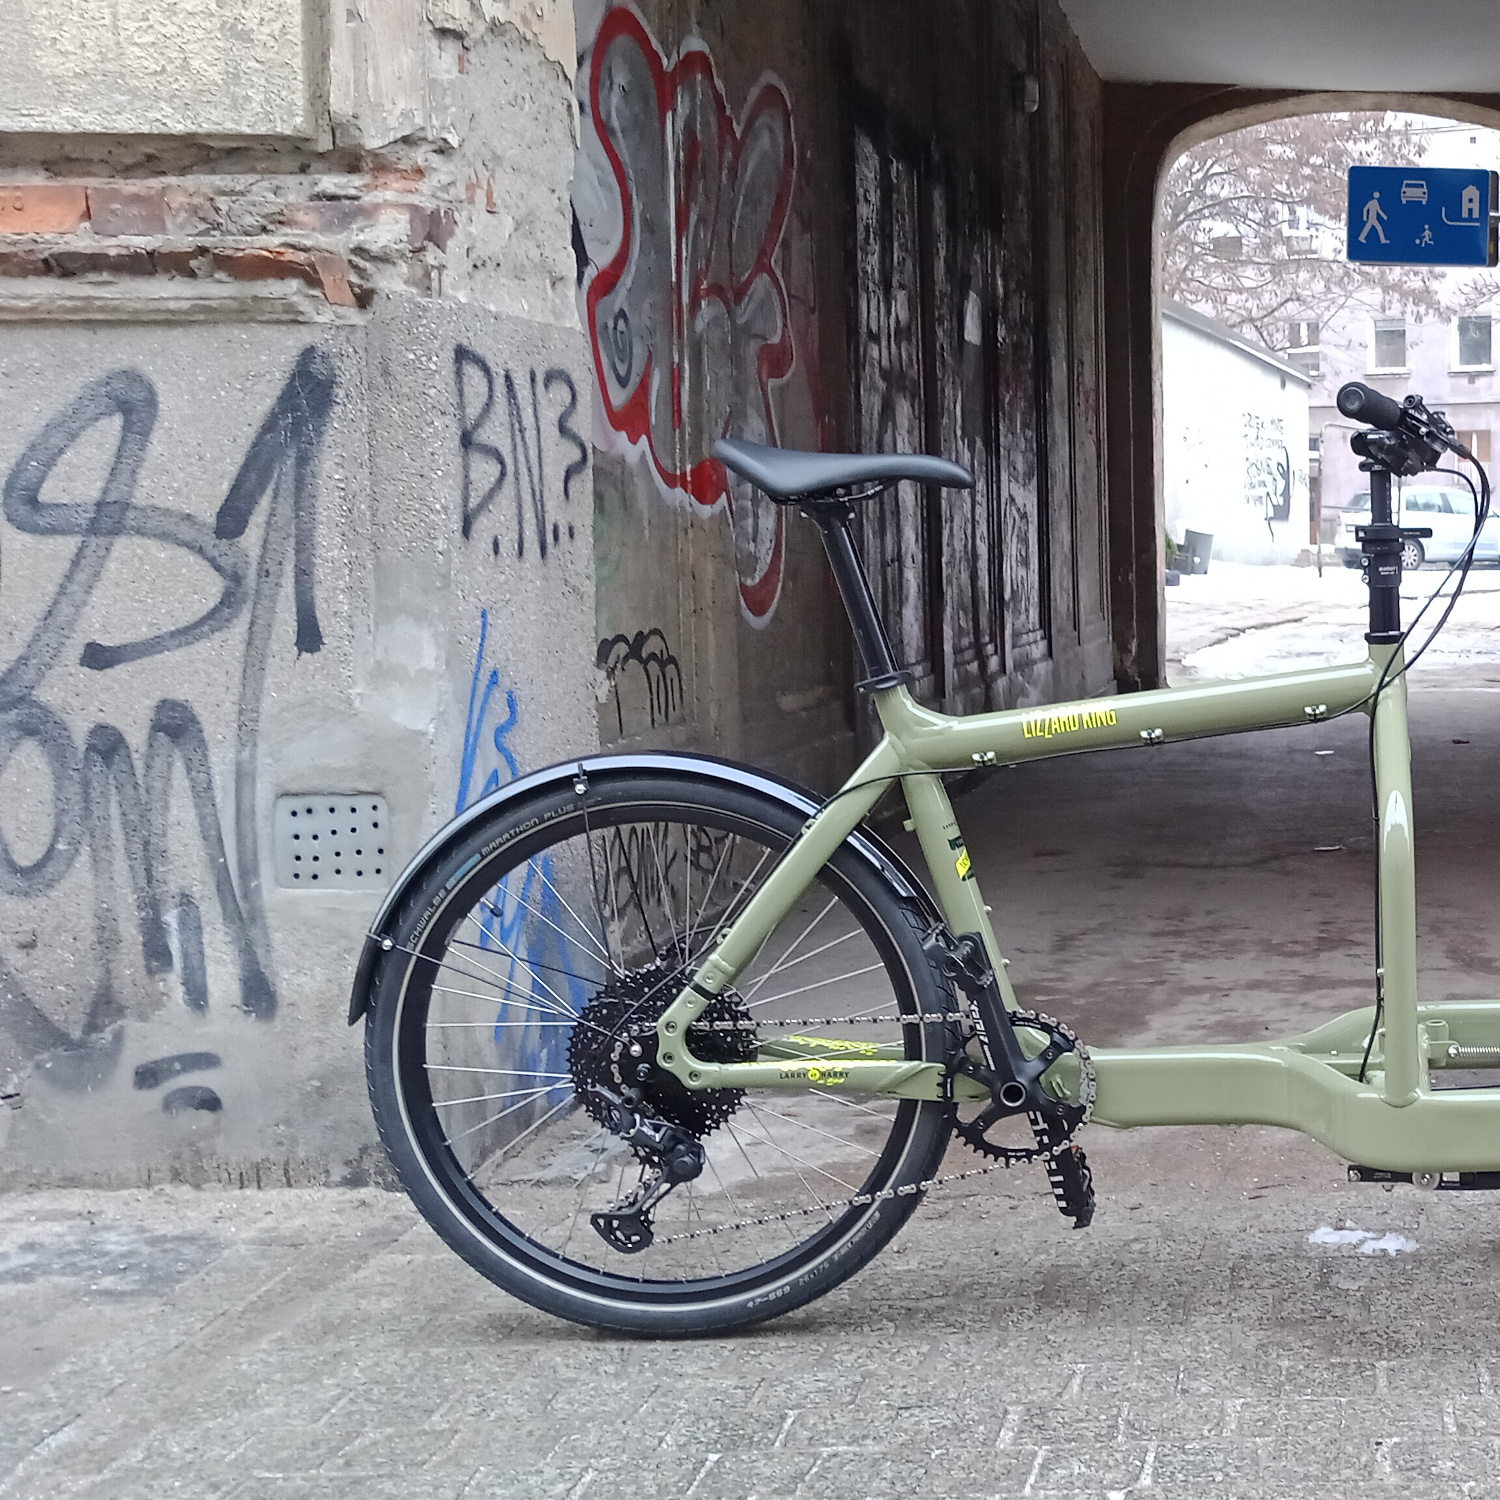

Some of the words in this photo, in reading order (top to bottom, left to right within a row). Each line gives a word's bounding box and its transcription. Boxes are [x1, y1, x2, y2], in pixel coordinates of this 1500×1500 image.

[1022, 704, 1079, 738] LIZZARD
[1081, 700, 1117, 729] KING
[481, 817, 539, 857] MARATHON
[543, 802, 576, 820] PLUS
[406, 887, 448, 950] SCHWALBE
[780, 1072, 807, 1080] LARRY
[820, 1070, 850, 1079] HARRY
